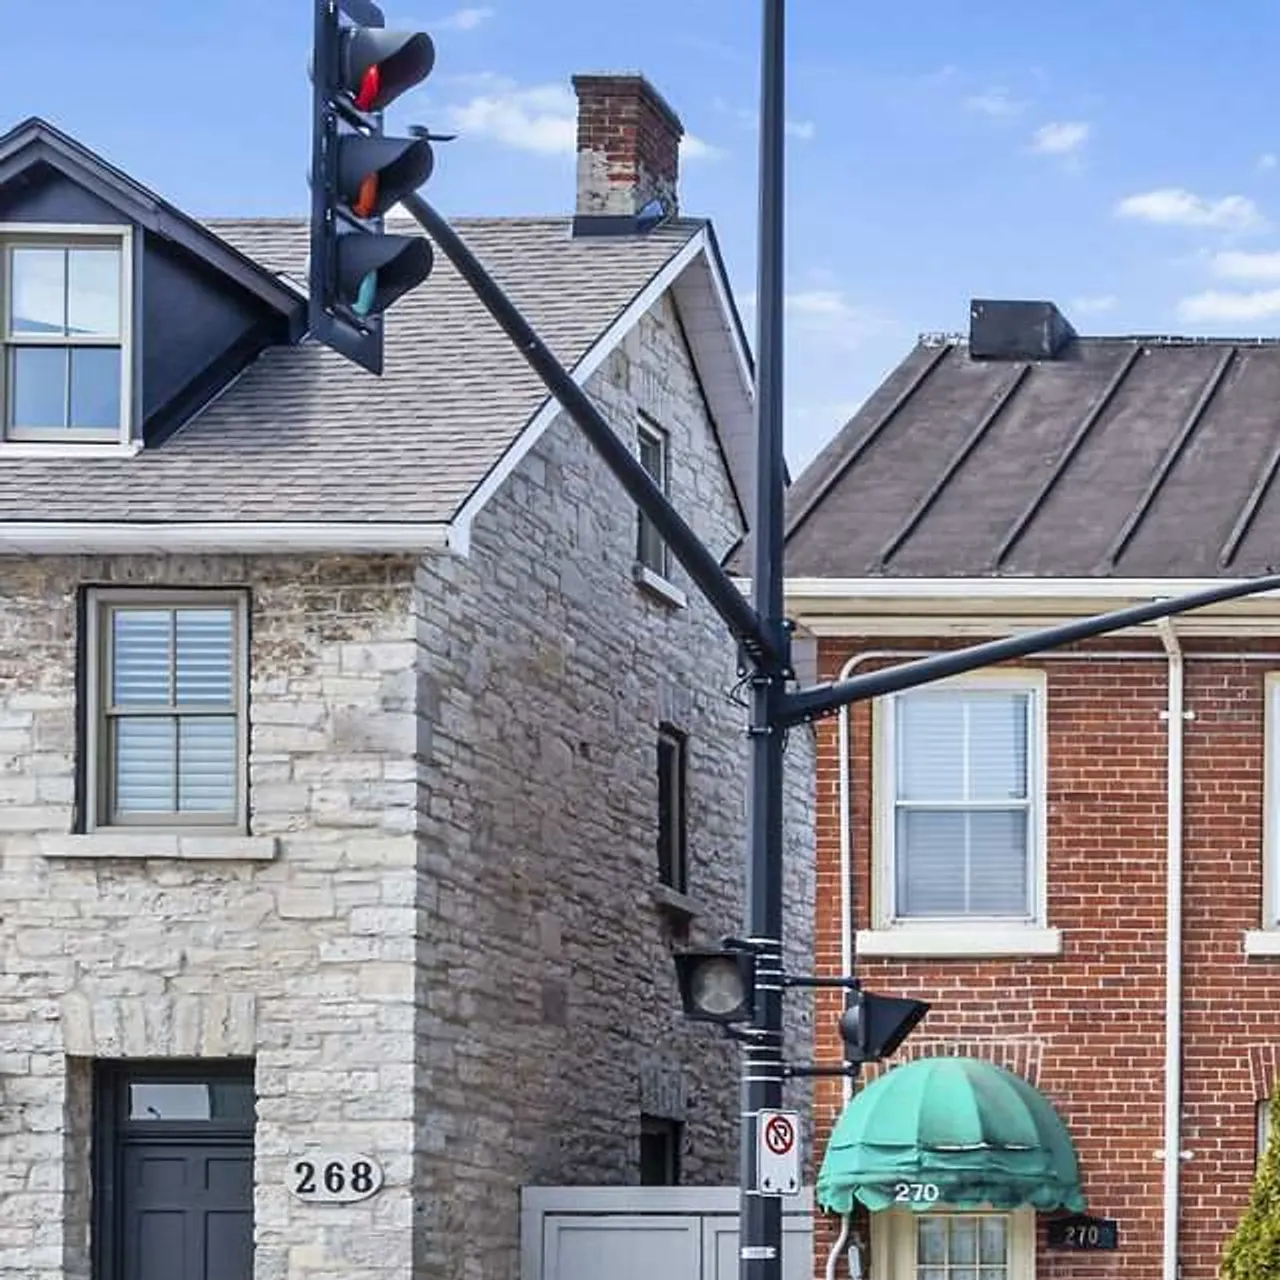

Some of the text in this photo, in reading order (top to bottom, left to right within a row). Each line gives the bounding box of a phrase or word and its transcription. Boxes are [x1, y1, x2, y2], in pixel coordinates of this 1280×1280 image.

[295, 1161, 374, 1194] 268
[894, 1183, 940, 1202] 270
[1064, 1224, 1099, 1247] 270
